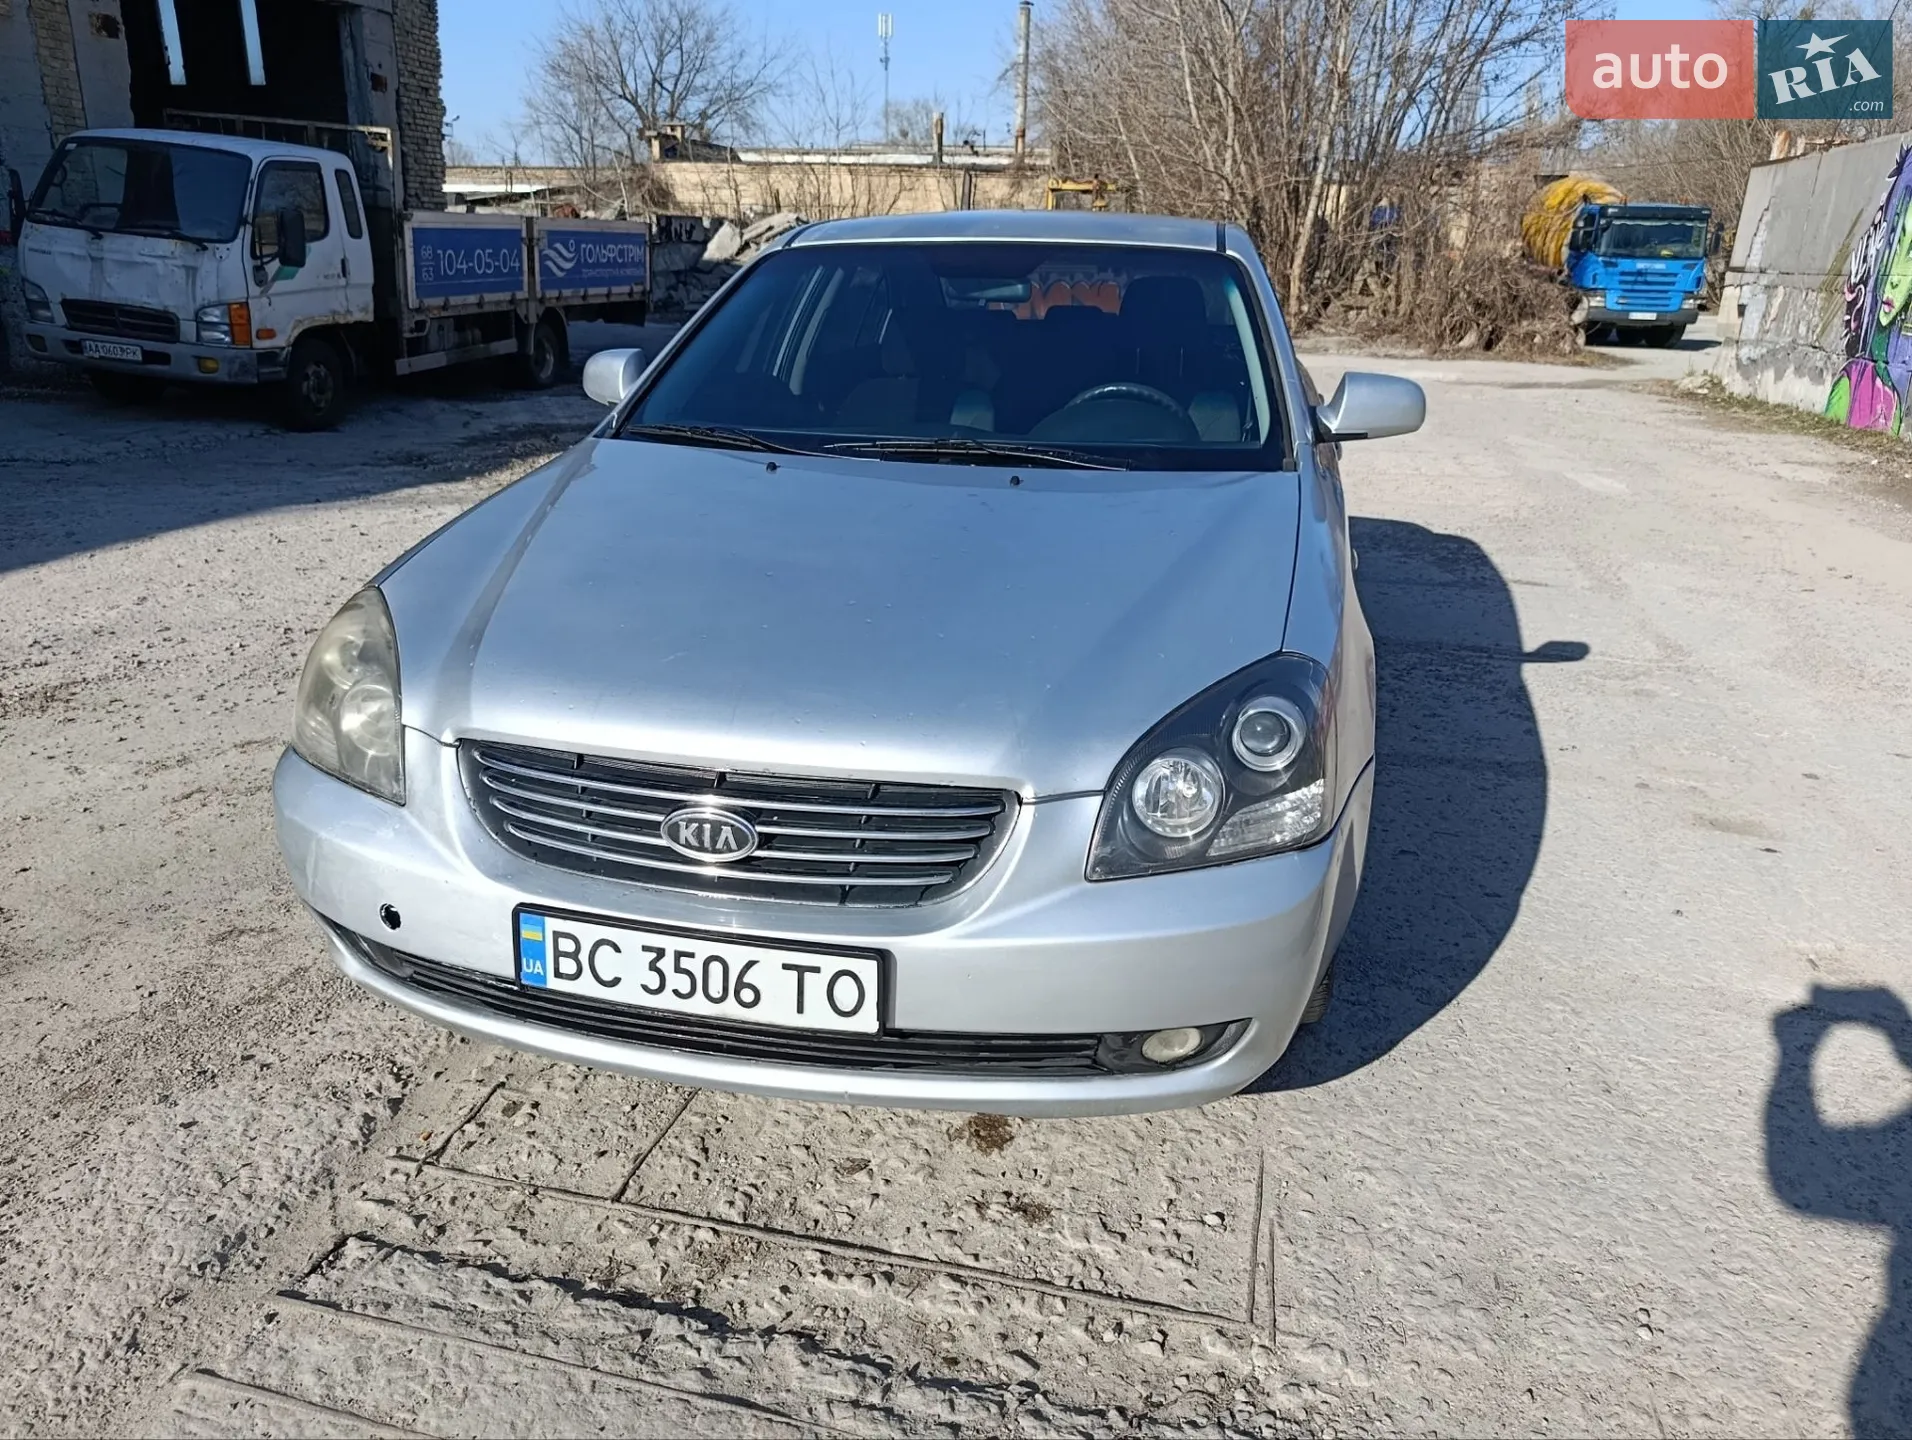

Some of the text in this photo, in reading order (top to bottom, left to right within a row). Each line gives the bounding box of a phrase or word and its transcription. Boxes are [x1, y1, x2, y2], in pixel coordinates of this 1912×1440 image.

[421, 244, 433, 259] 68
[436, 248, 520, 275] 104-05-04
[580, 243, 645, 264] ГОЛЬФСТРІМ
[421, 266, 434, 281] 63
[678, 821, 738, 850] KIA
[523, 957, 544, 977] UA
[552, 930, 866, 1018] BC 3506 TO
